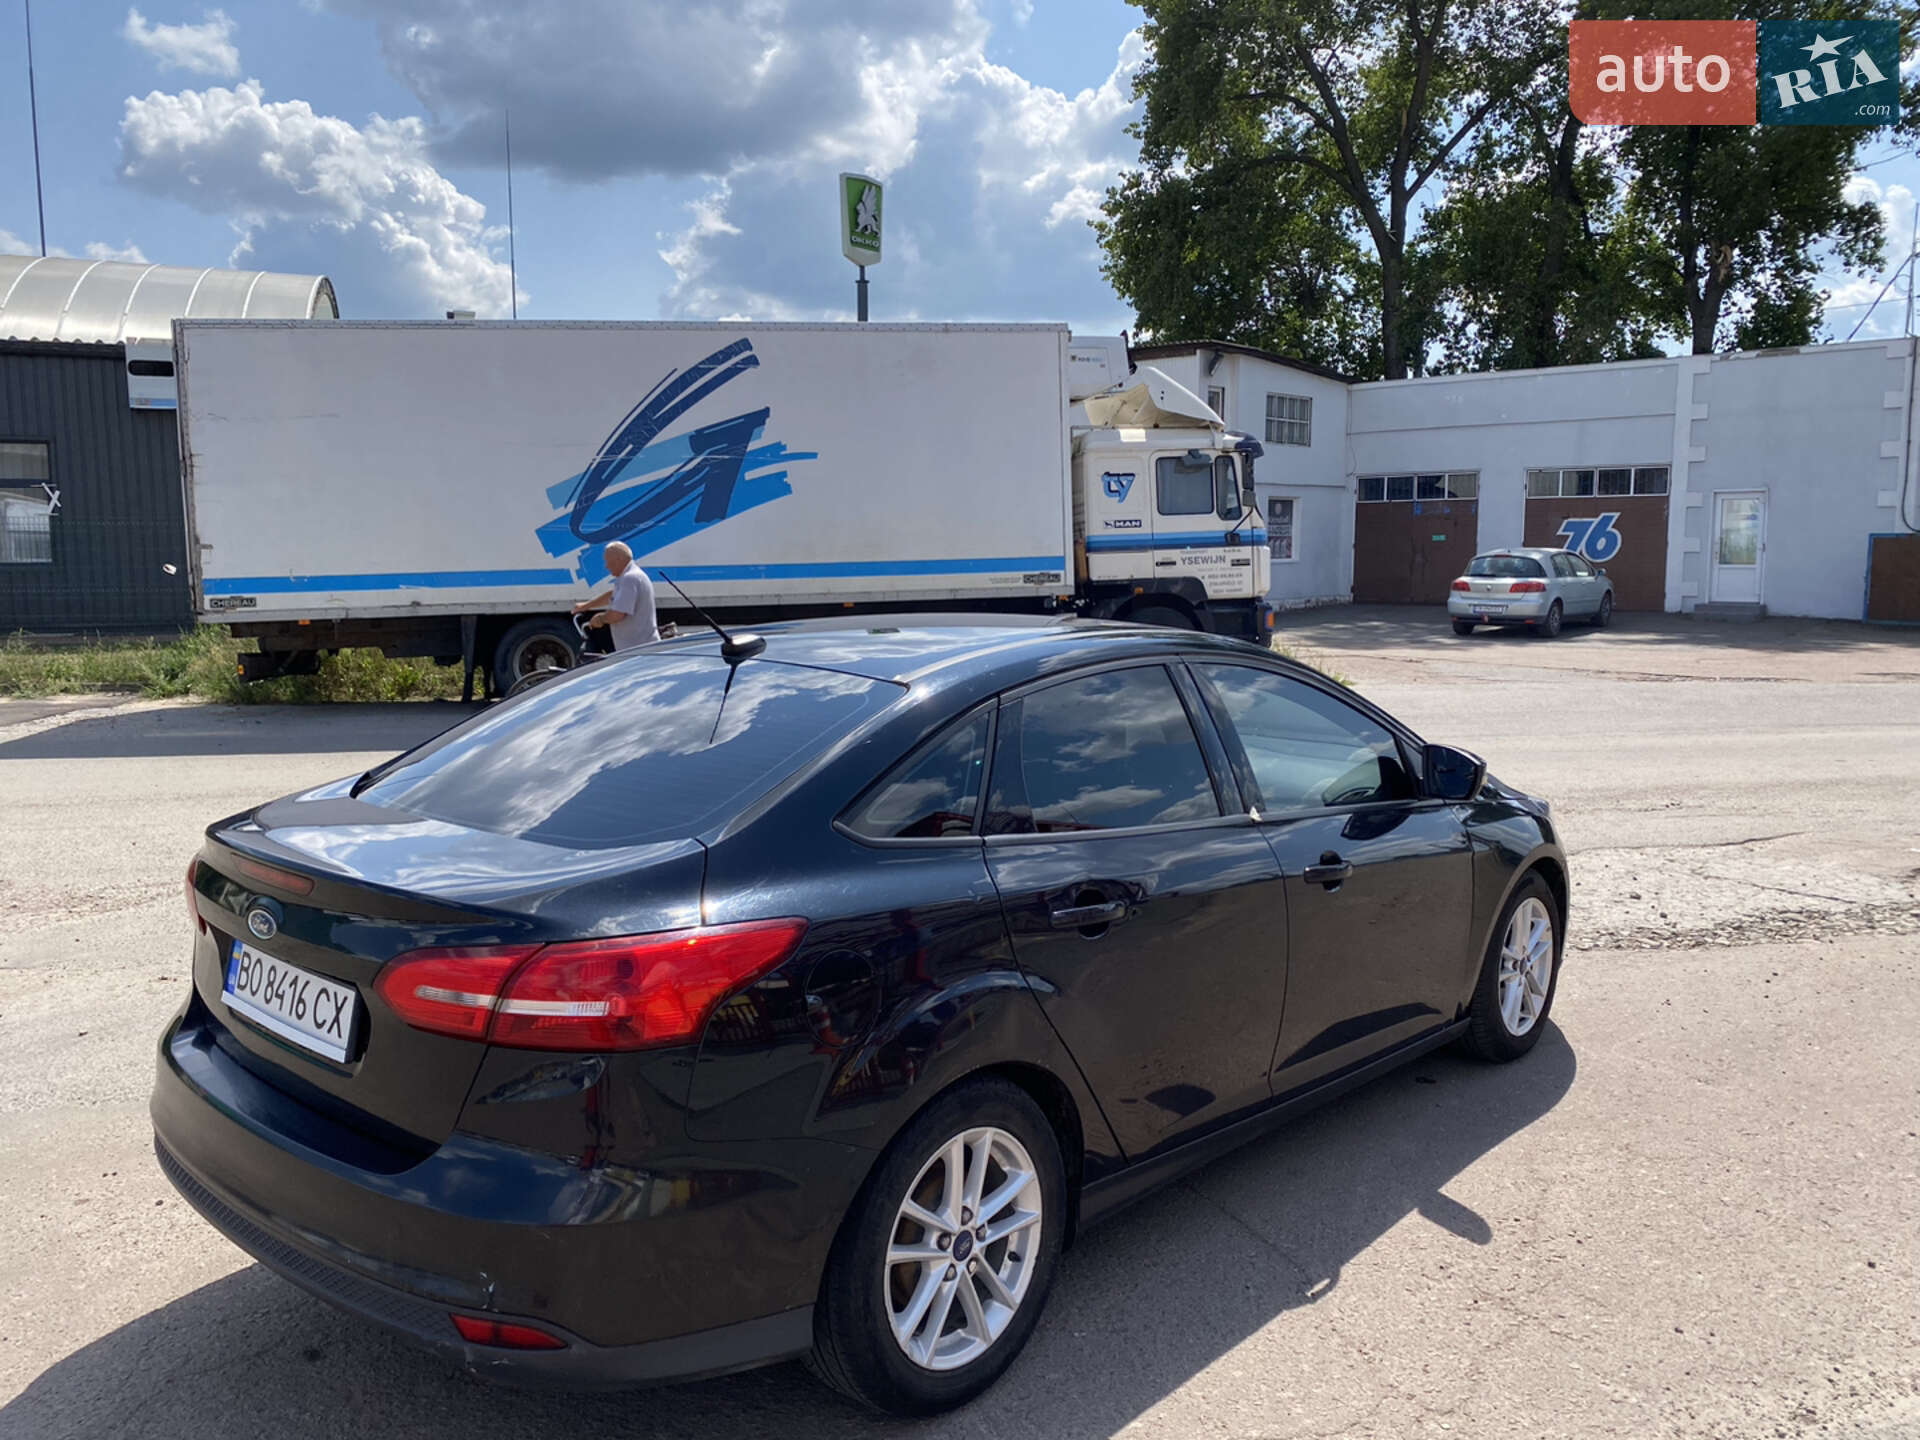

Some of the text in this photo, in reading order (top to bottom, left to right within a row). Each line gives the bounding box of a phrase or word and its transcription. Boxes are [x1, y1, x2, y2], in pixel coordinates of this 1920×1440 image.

[1115, 520, 1141, 528] MAN
[1556, 511, 1622, 562] 76
[237, 951, 348, 1039] BO 8416 CX
